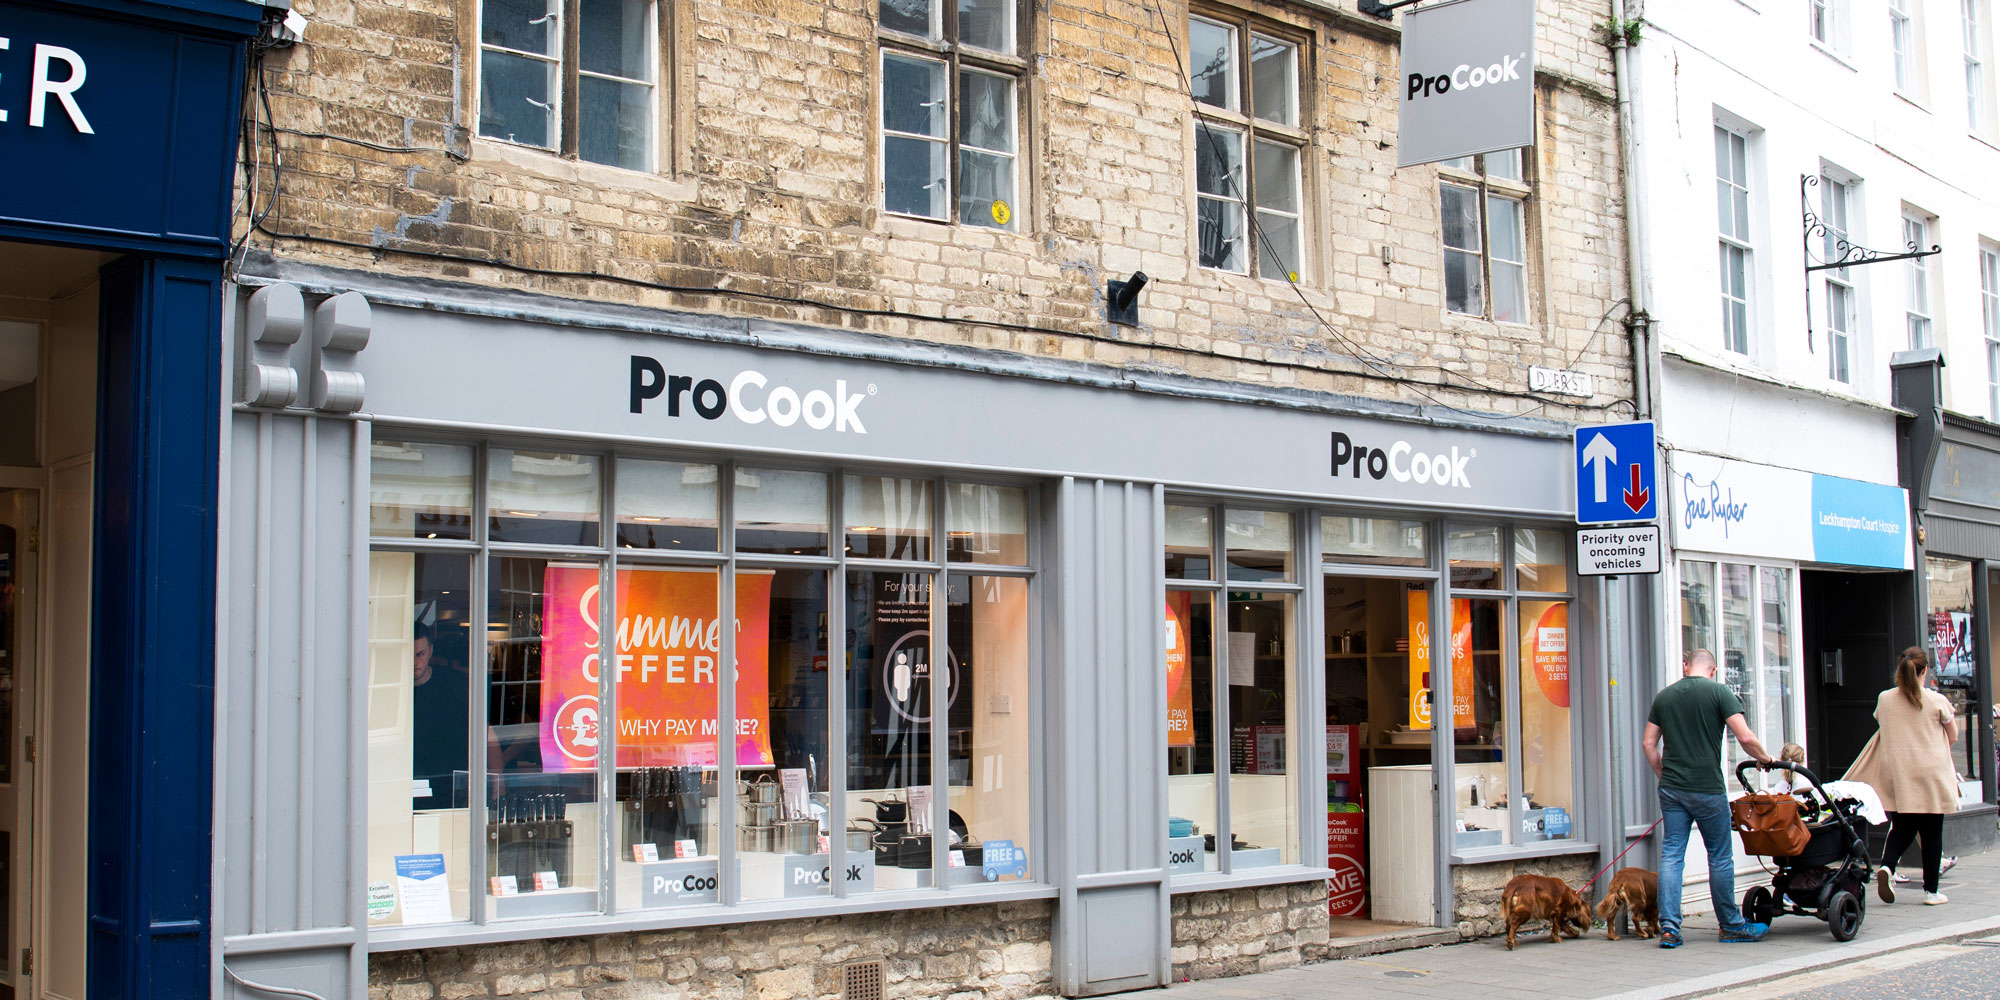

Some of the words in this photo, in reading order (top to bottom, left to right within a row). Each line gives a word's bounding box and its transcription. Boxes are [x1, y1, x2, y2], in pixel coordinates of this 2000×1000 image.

[0, 36, 95, 134] R
[1537, 371, 1569, 390] DER
[1684, 472, 1710, 530] Sue
[1710, 480, 1747, 539] Ryder
[1819, 510, 1861, 531] Leckhampton
[1861, 516, 1879, 532] Court
[1879, 519, 1900, 535] Hospice
[1582, 533, 1624, 545] Priority
[1628, 534, 1653, 543] over
[1590, 545, 1645, 557] oncoming
[1594, 558, 1641, 569] vehicles
[884, 580, 900, 592] For
[902, 583, 923, 595] your
[1406, 582, 1424, 591] Red
[1936, 622, 1956, 648] sale
[1166, 653, 1183, 663] HEN
[1535, 655, 1549, 663] SAVE
[1551, 655, 1567, 663] WHEN
[582, 653, 739, 683] OFFER
[915, 663, 928, 673] 2M
[1543, 664, 1555, 672] YOU
[1556, 664, 1567, 672] BUY
[1553, 672, 1567, 680] SETS
[1456, 695, 1469, 704] PAY
[1172, 709, 1187, 719] PAY
[1453, 704, 1470, 715] RE?
[619, 719, 661, 736] WHY
[665, 719, 697, 735] PAY
[1167, 719, 1188, 731] RE?
[1545, 814, 1563, 825] FREE
[1328, 827, 1359, 835] EATABLE
[1328, 834, 1348, 842] FFER
[985, 848, 1013, 863] FREE
[653, 873, 718, 894] ProCoo
[1328, 871, 1361, 893] AVE
